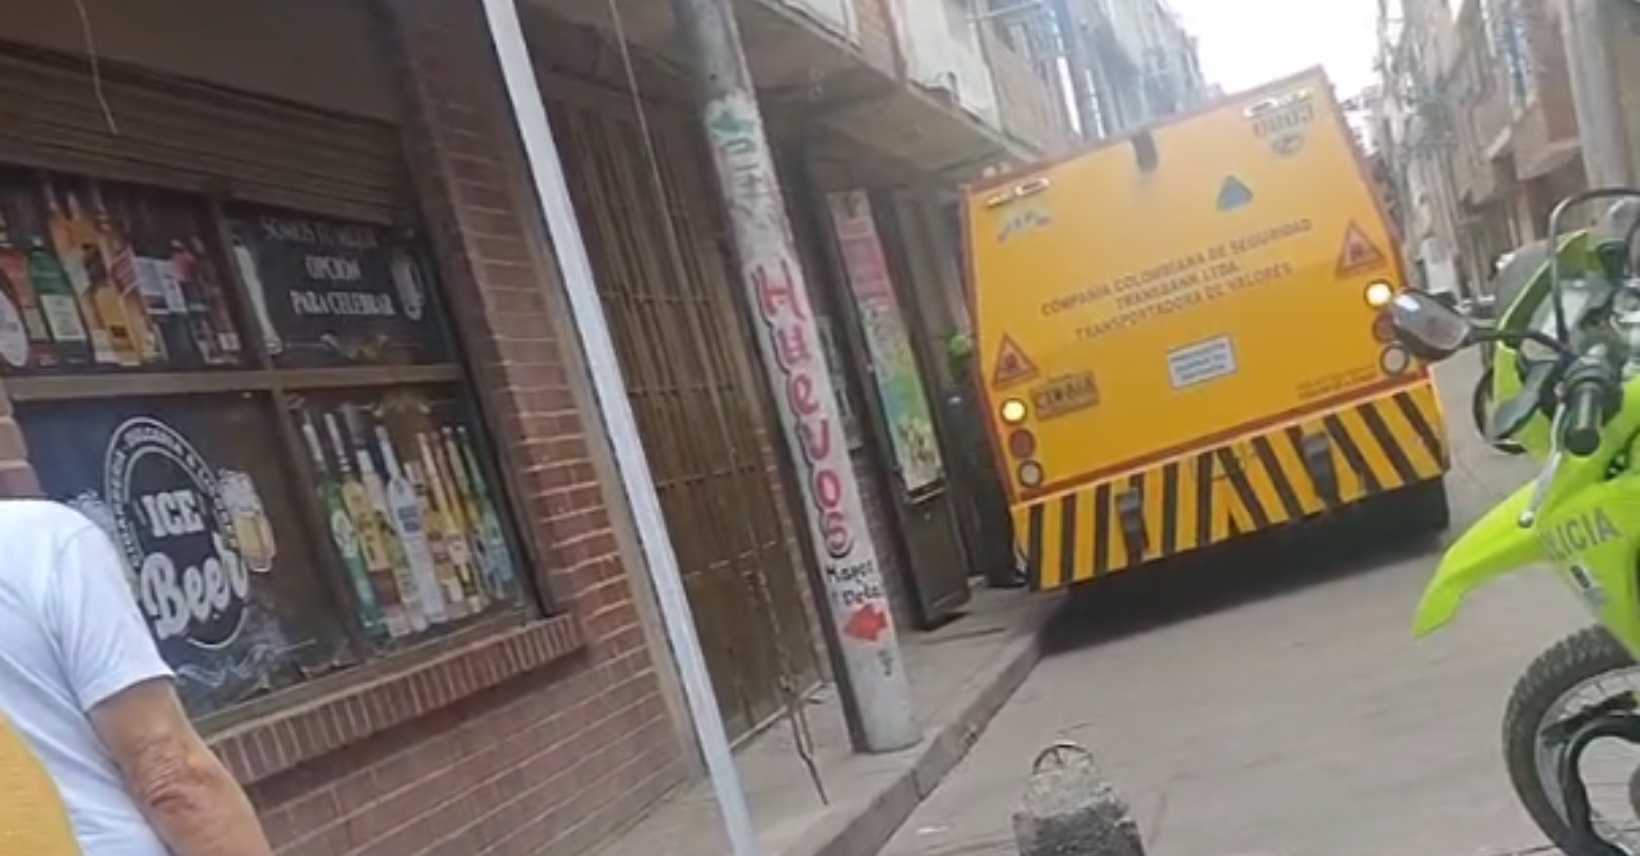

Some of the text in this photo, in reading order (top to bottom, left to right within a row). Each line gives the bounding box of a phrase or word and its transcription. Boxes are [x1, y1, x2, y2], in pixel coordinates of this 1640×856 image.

[1208, 244, 1227, 262] DE
[1229, 217, 1313, 256] SEGURIDAD
[289, 289, 397, 316] PARA CELEBRAR
[1075, 261, 1292, 341] TRANSPORTADORA DE VALORES
[142, 489, 205, 537] ICE
[139, 531, 250, 641] Beer
